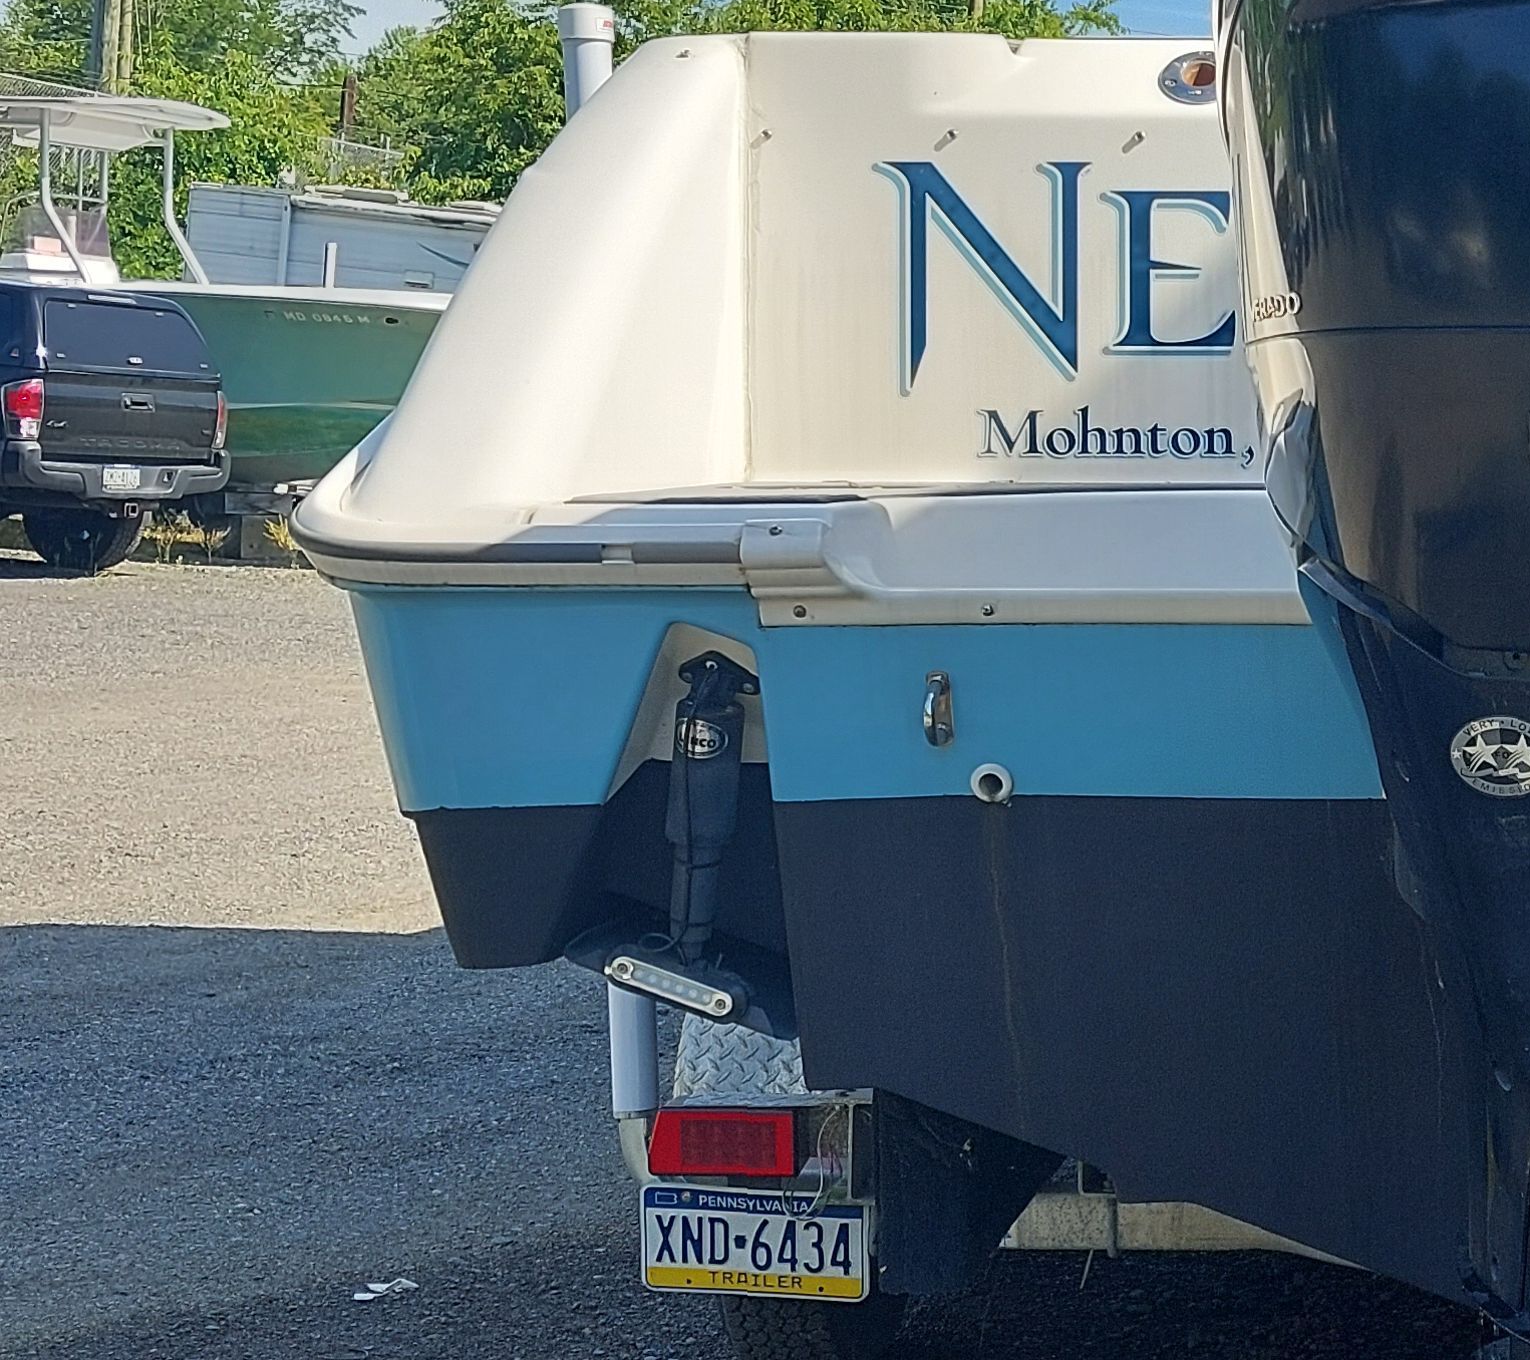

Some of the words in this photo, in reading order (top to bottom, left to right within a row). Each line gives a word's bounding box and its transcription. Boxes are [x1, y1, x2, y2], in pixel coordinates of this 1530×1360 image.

[975, 403, 1256, 469] Mohnton,
[1462, 719, 1495, 737] VERY
[709, 1270, 803, 1289] TRAILER
